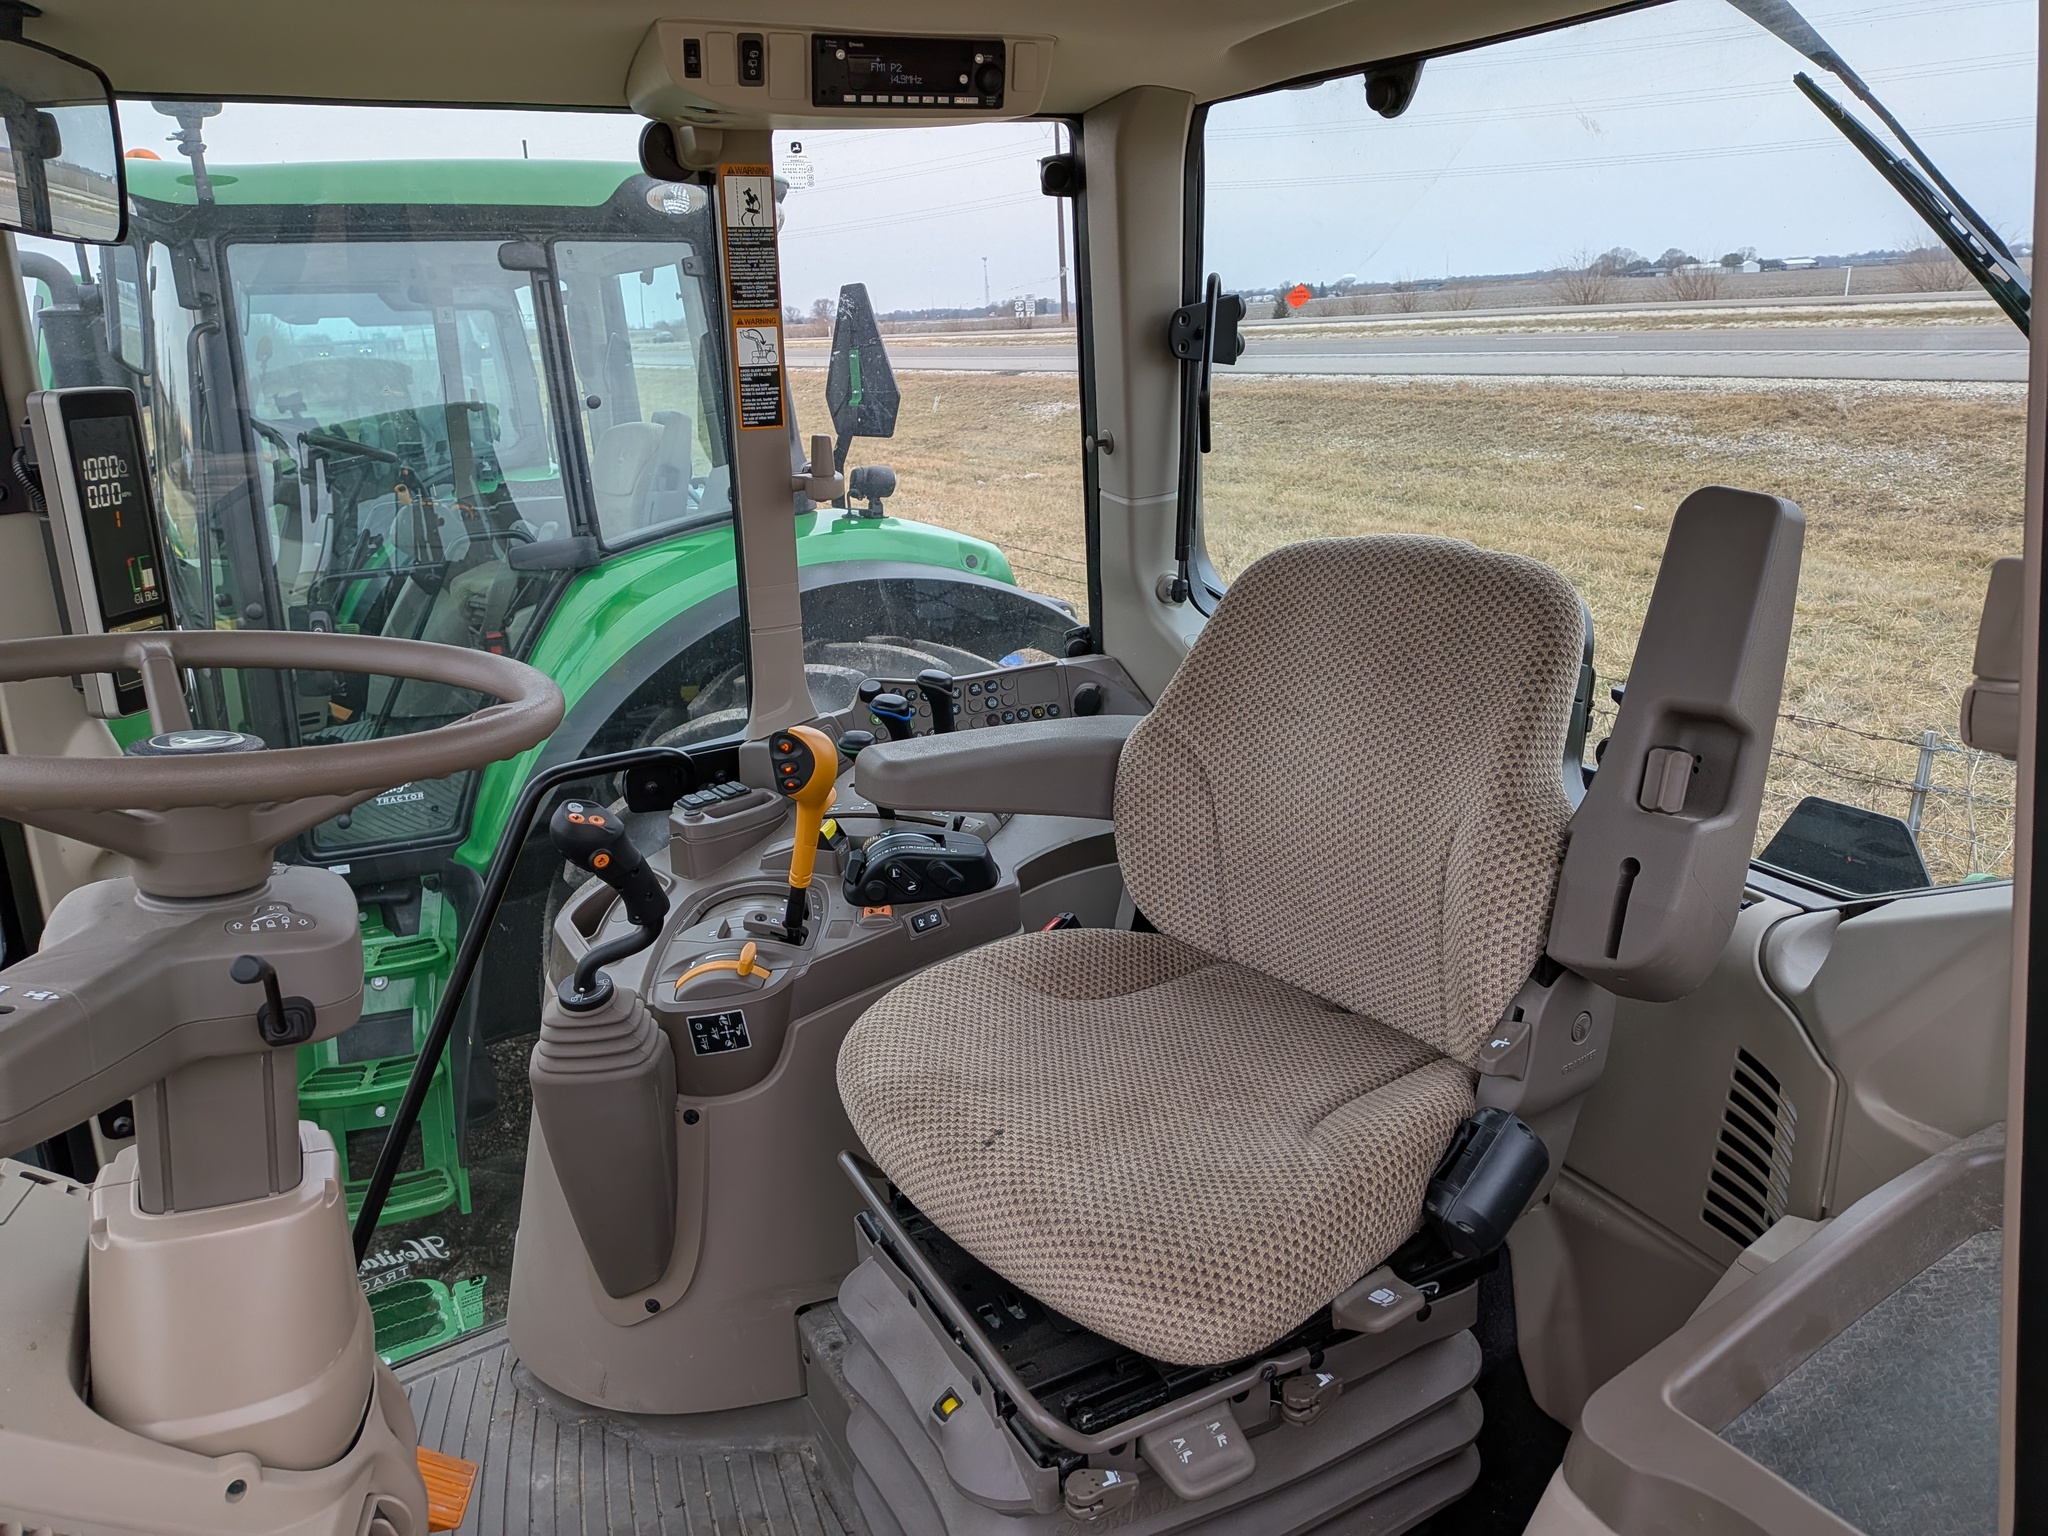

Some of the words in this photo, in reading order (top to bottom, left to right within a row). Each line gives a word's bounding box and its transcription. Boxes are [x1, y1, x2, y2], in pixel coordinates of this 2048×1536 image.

[871, 62, 886, 72] FM1
[890, 62, 903, 73] P2
[735, 166, 770, 175] WARNING
[744, 317, 777, 326] WARNING
[83, 455, 120, 481] 1000
[87, 482, 122, 509] 0.00
[376, 792, 424, 805] TRACTOR
